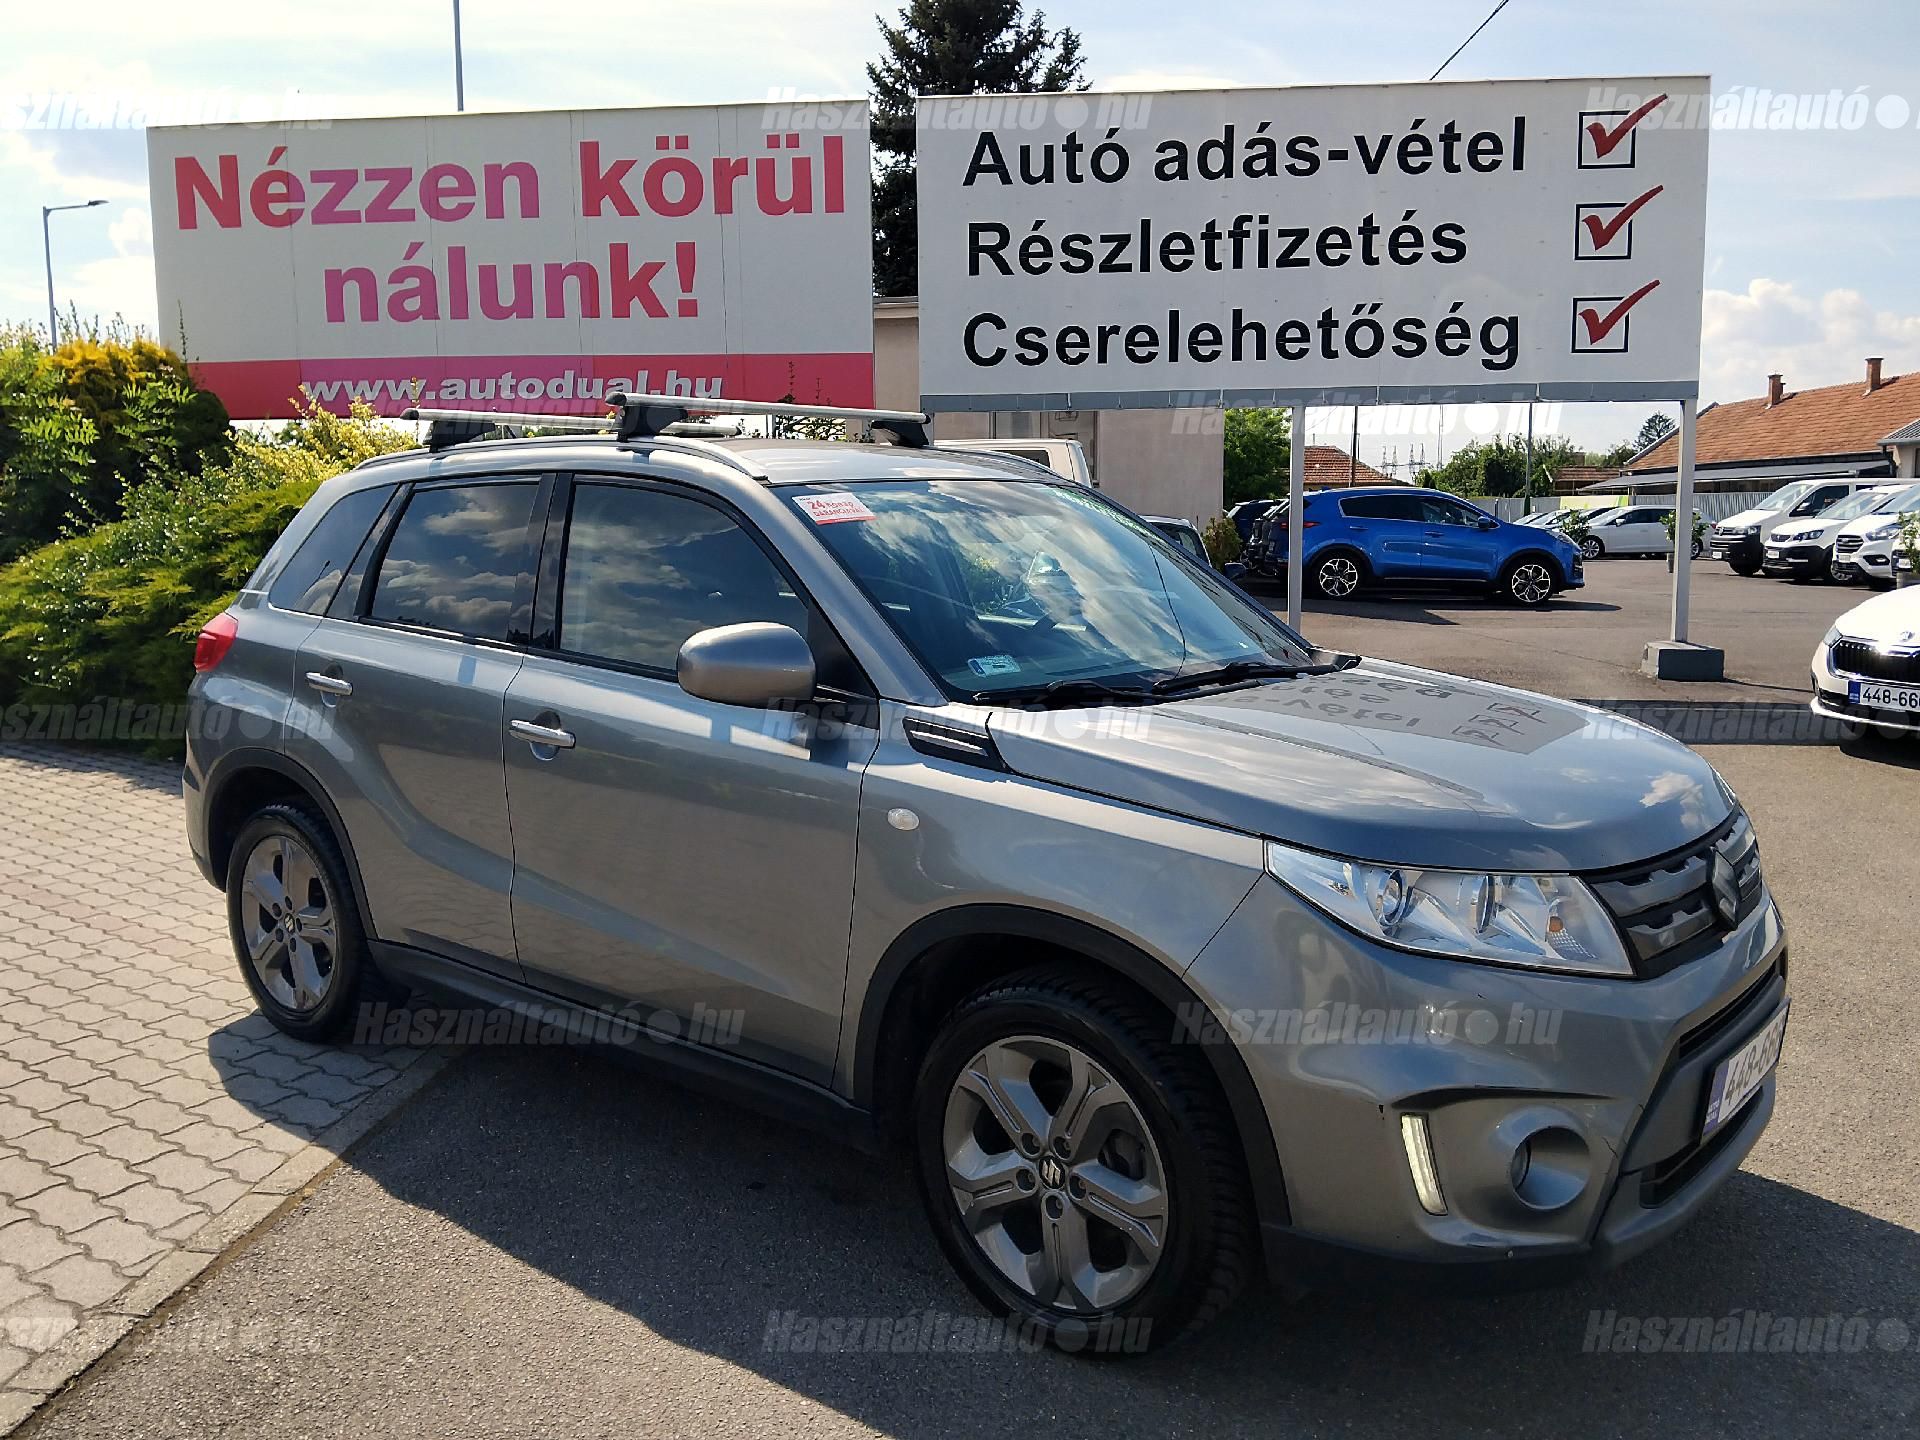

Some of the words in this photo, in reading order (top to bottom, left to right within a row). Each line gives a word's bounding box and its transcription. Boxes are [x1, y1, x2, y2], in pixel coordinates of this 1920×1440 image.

[174, 146, 540, 230] Nézzen
[579, 134, 845, 218] körül
[962, 127, 1130, 187] Autó
[1153, 116, 1526, 181] adás-vétel
[968, 209, 1467, 276] Részletfizetés
[324, 241, 698, 323] nálunk!
[963, 302, 1520, 371] Cserelehetőség
[302, 369, 723, 402] www.autodual.hu
[1862, 687, 1920, 709] 448-66
